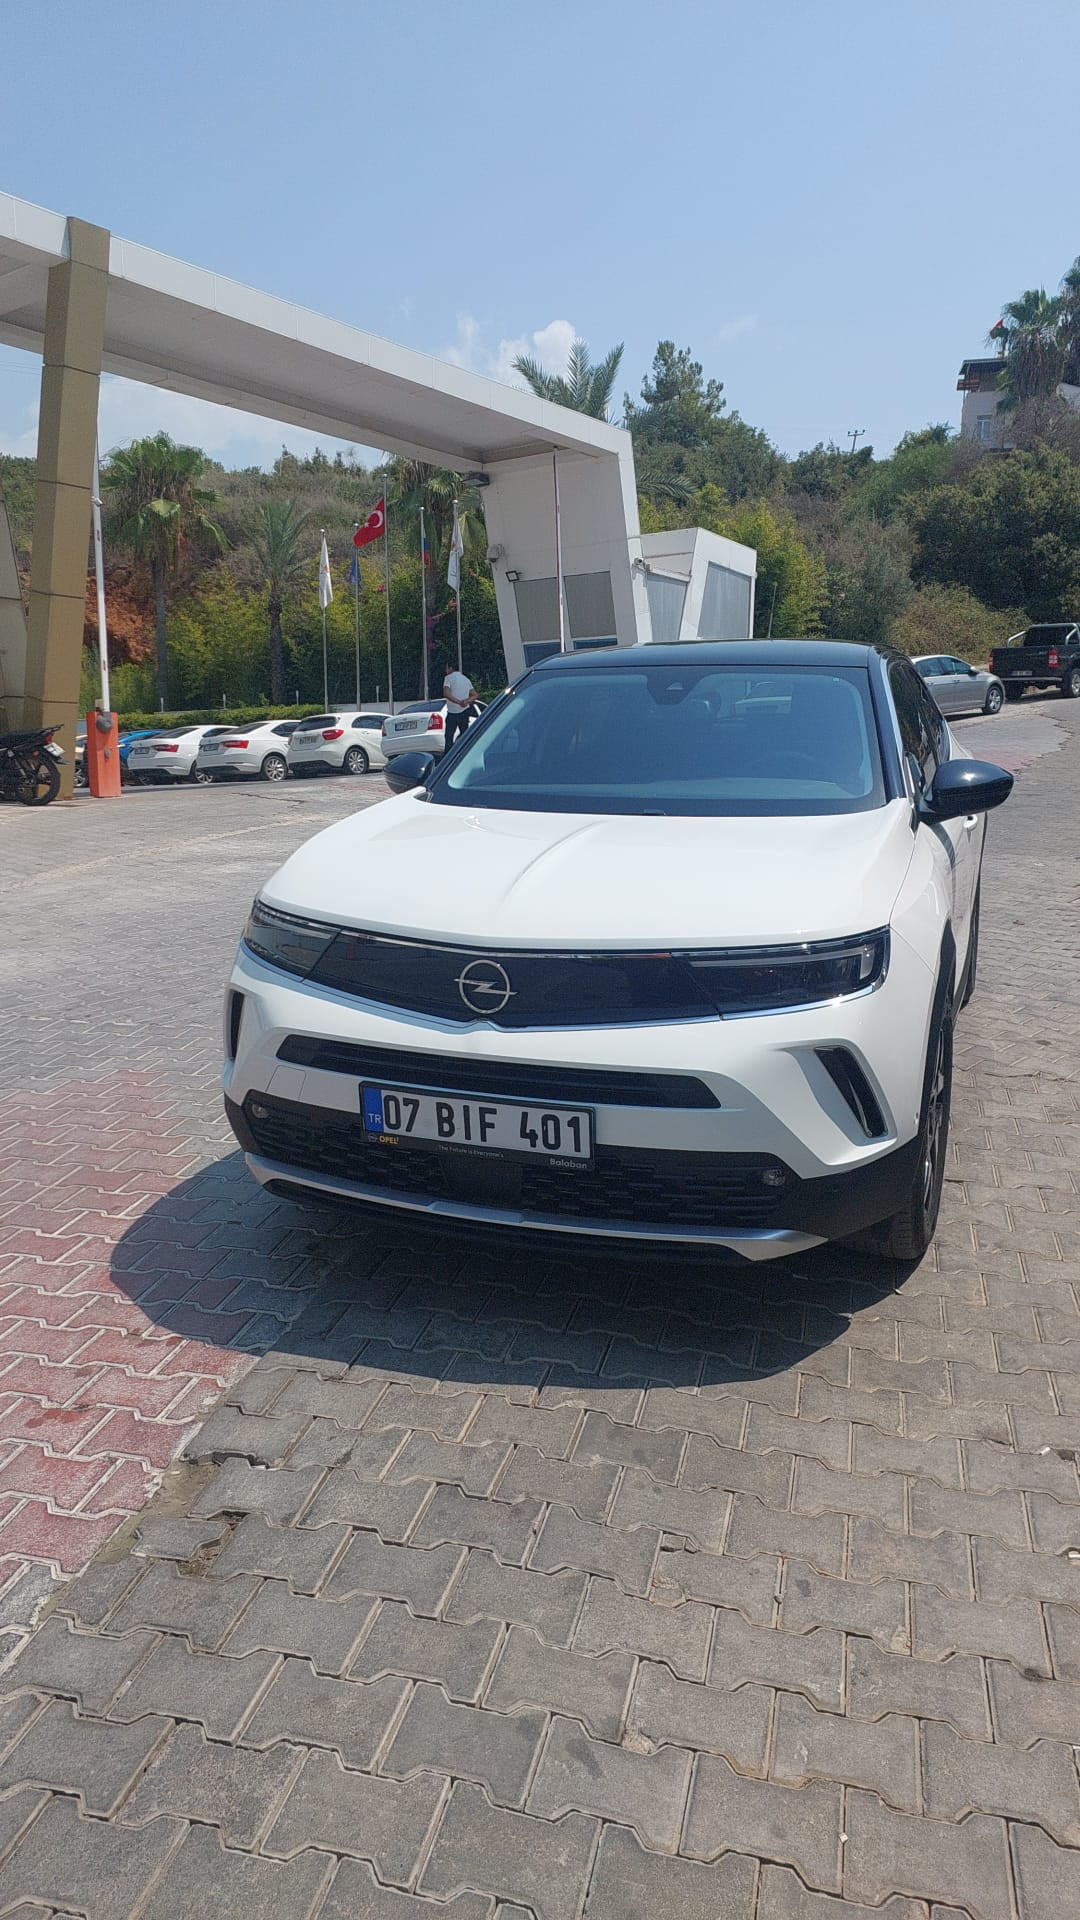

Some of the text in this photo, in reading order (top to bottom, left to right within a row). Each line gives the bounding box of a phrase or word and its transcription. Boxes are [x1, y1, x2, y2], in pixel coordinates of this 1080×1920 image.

[367, 1112, 382, 1125] TR
[383, 1094, 582, 1153] 07 BIF 401
[549, 1157, 588, 1170] Balaban
